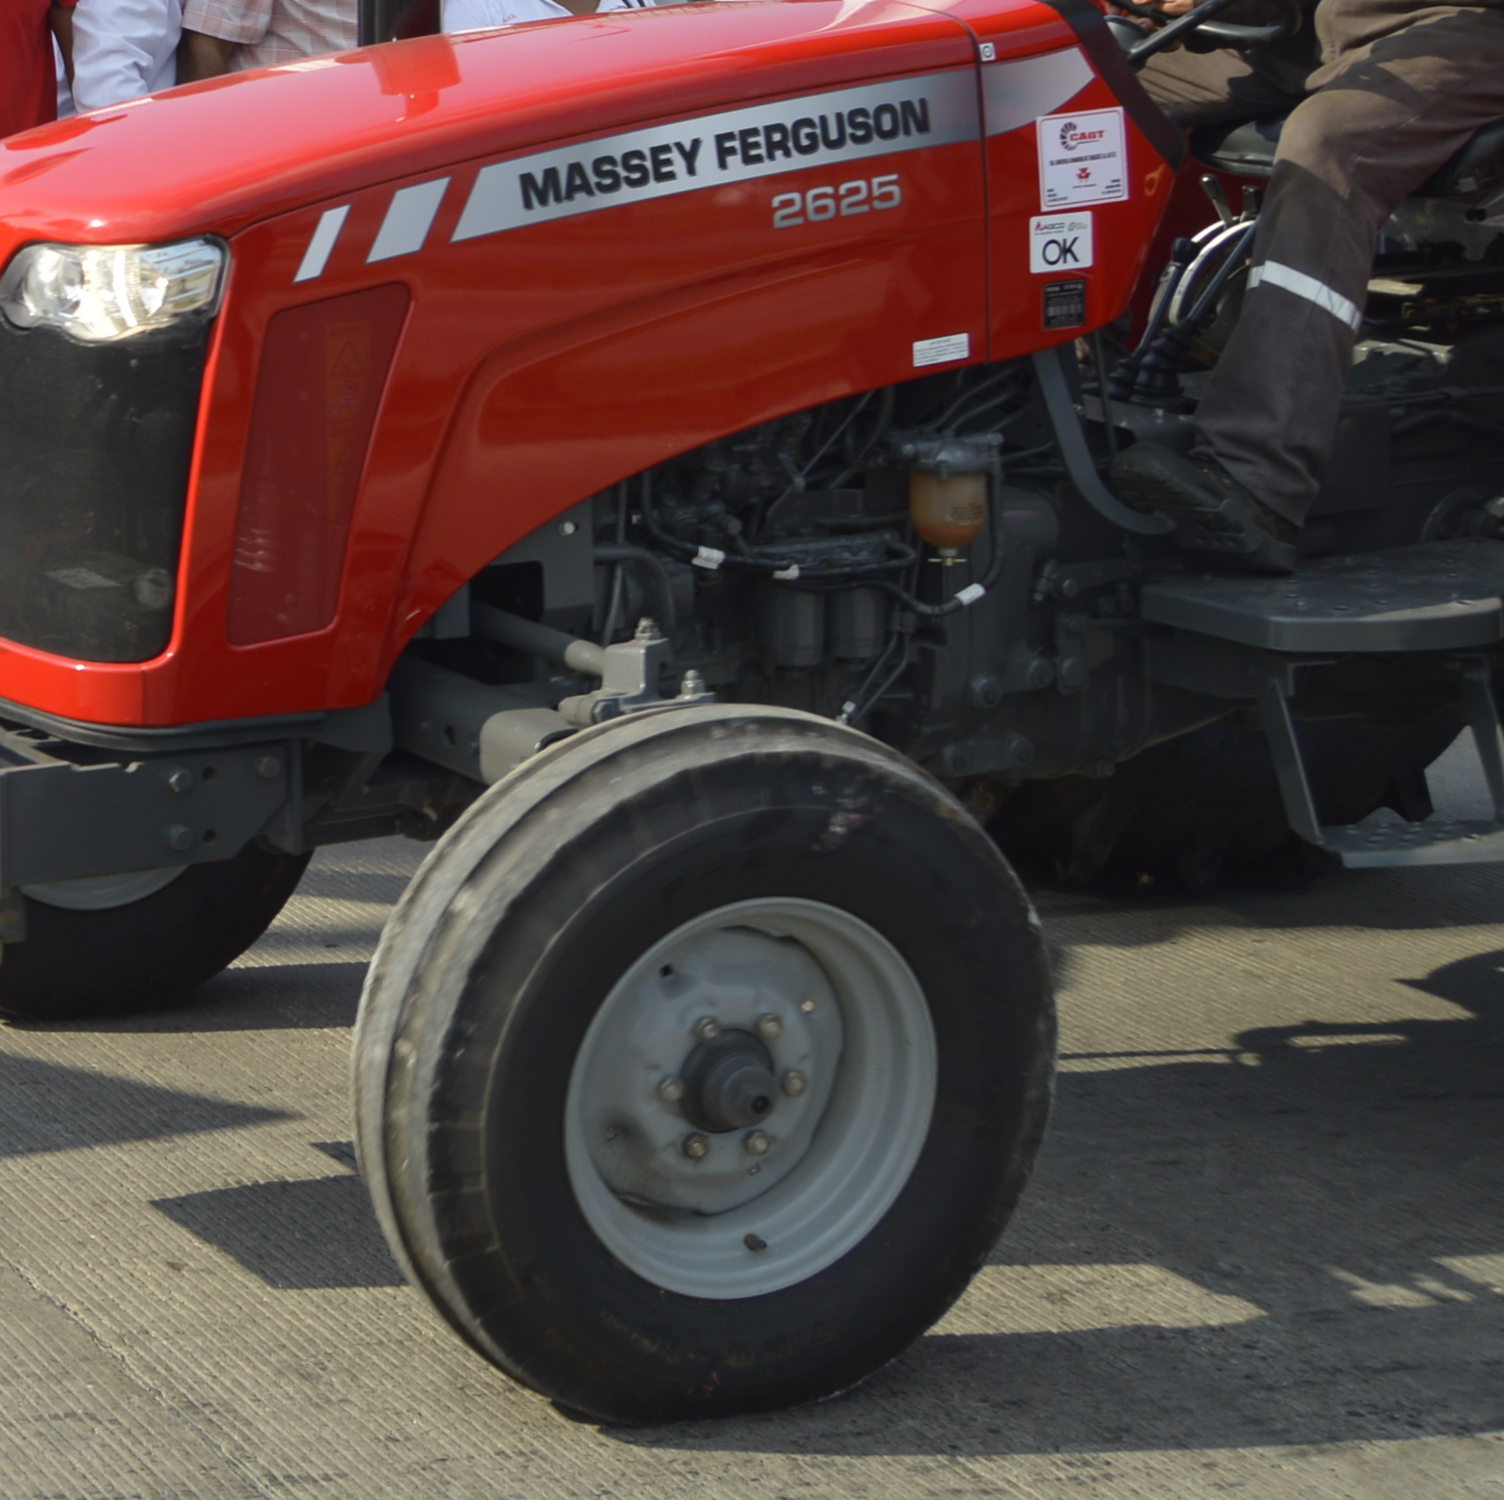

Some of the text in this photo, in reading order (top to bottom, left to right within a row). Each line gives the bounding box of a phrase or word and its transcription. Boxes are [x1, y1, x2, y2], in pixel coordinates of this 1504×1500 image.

[517, 97, 932, 212] MASSEY FERGUSON
[771, 173, 902, 229] 2625
[1042, 236, 1080, 266] OK
